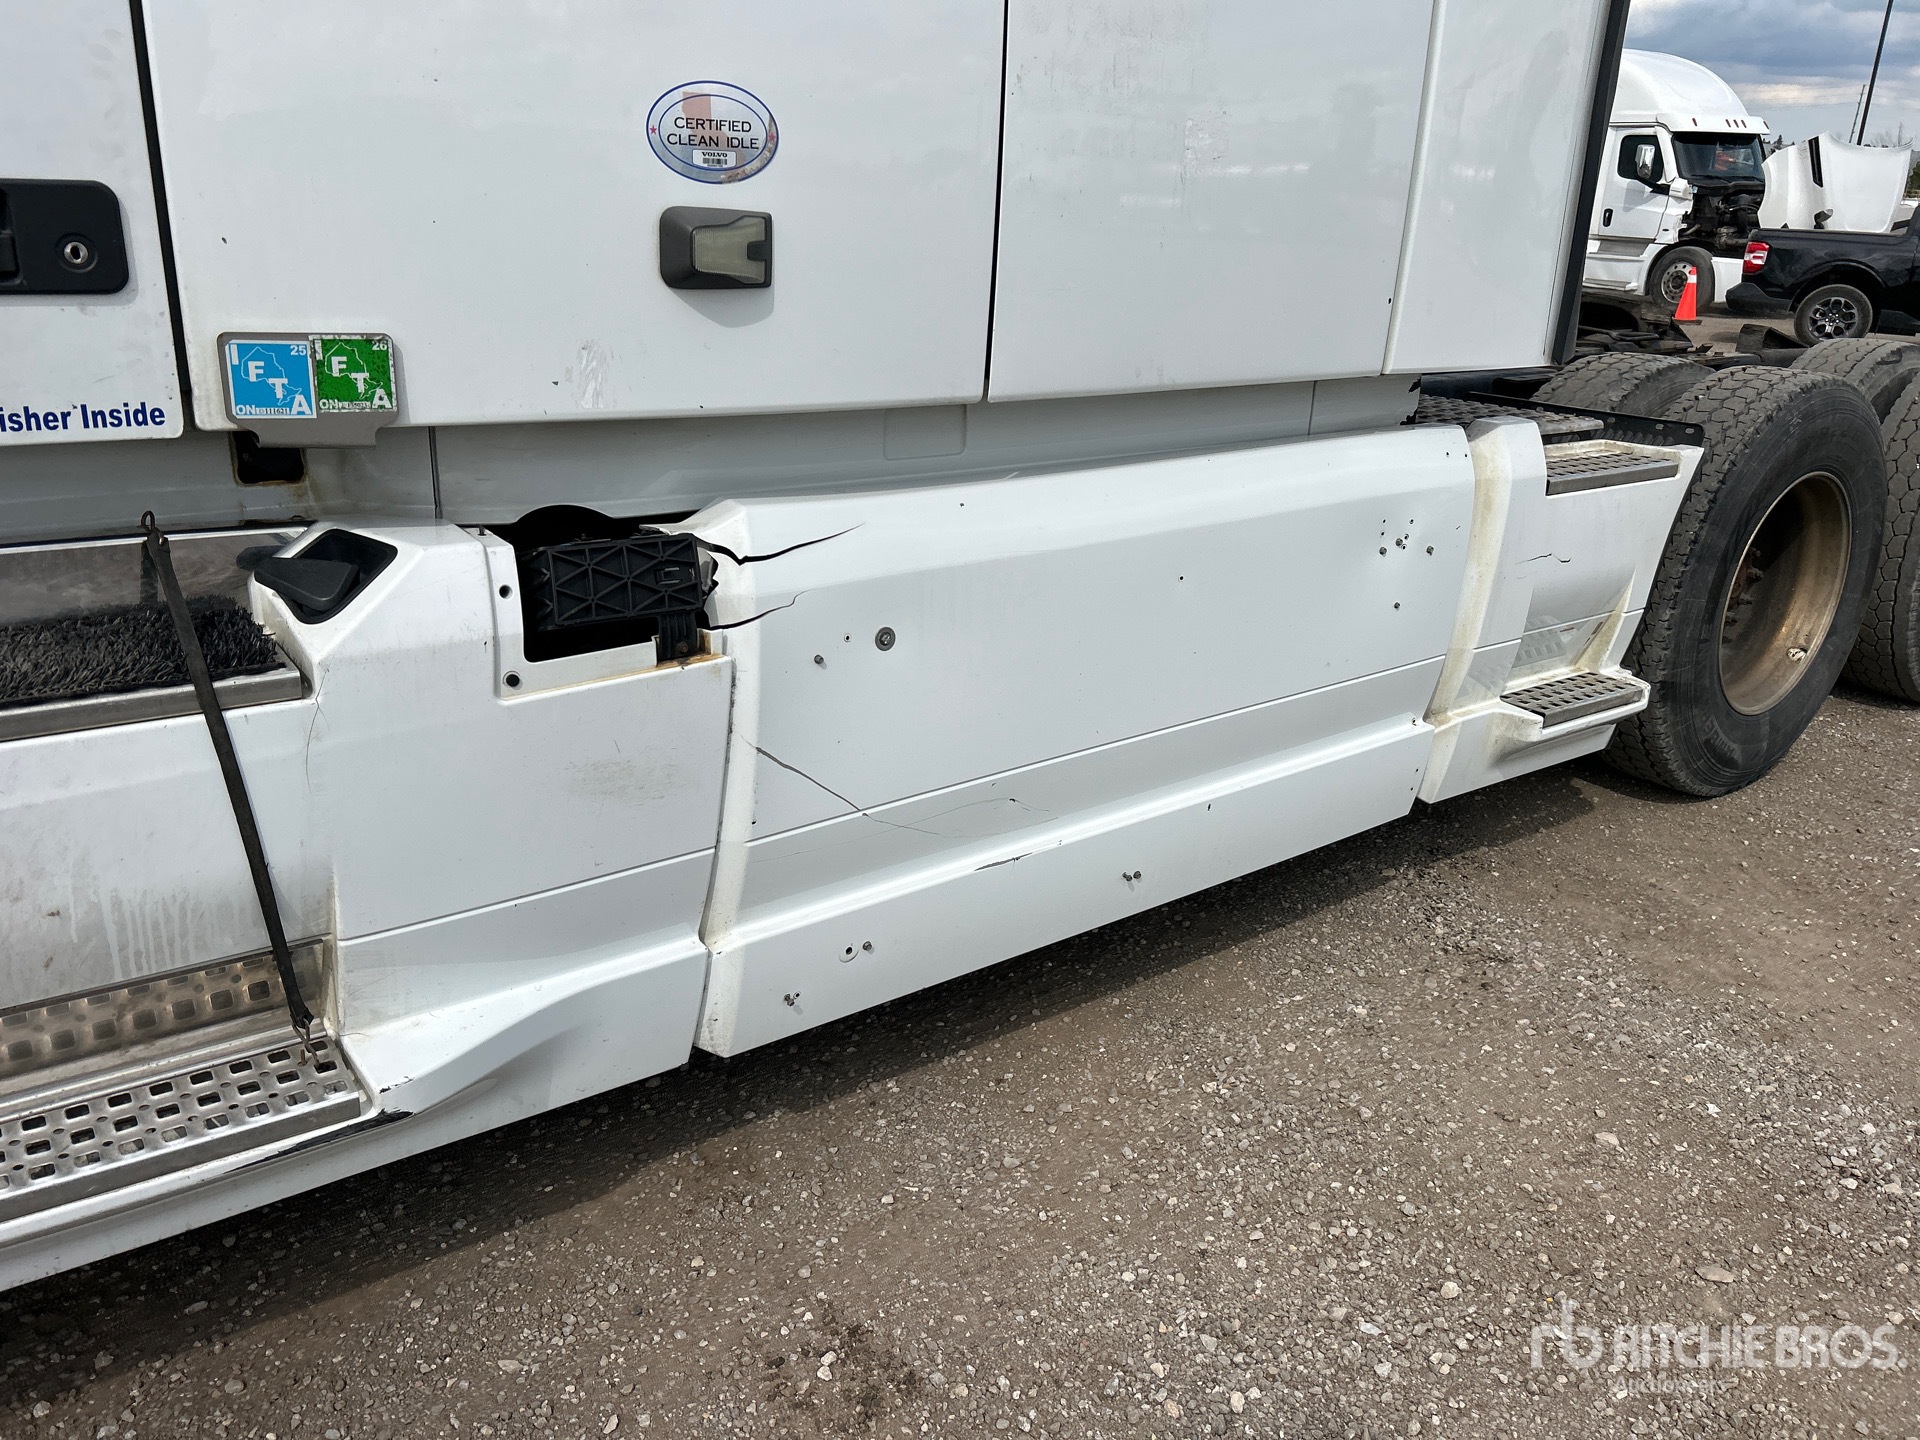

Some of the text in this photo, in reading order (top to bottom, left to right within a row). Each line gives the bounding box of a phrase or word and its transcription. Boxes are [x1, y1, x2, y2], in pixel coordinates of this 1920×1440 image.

[673, 116, 752, 133] CERTIFIED
[666, 133, 760, 150] CLEAN IDLE
[289, 345, 307, 356] 25
[371, 340, 388, 351] 26
[235, 404, 256, 415] ON
[319, 398, 339, 410] ON
[80, 401, 166, 429] Inside
